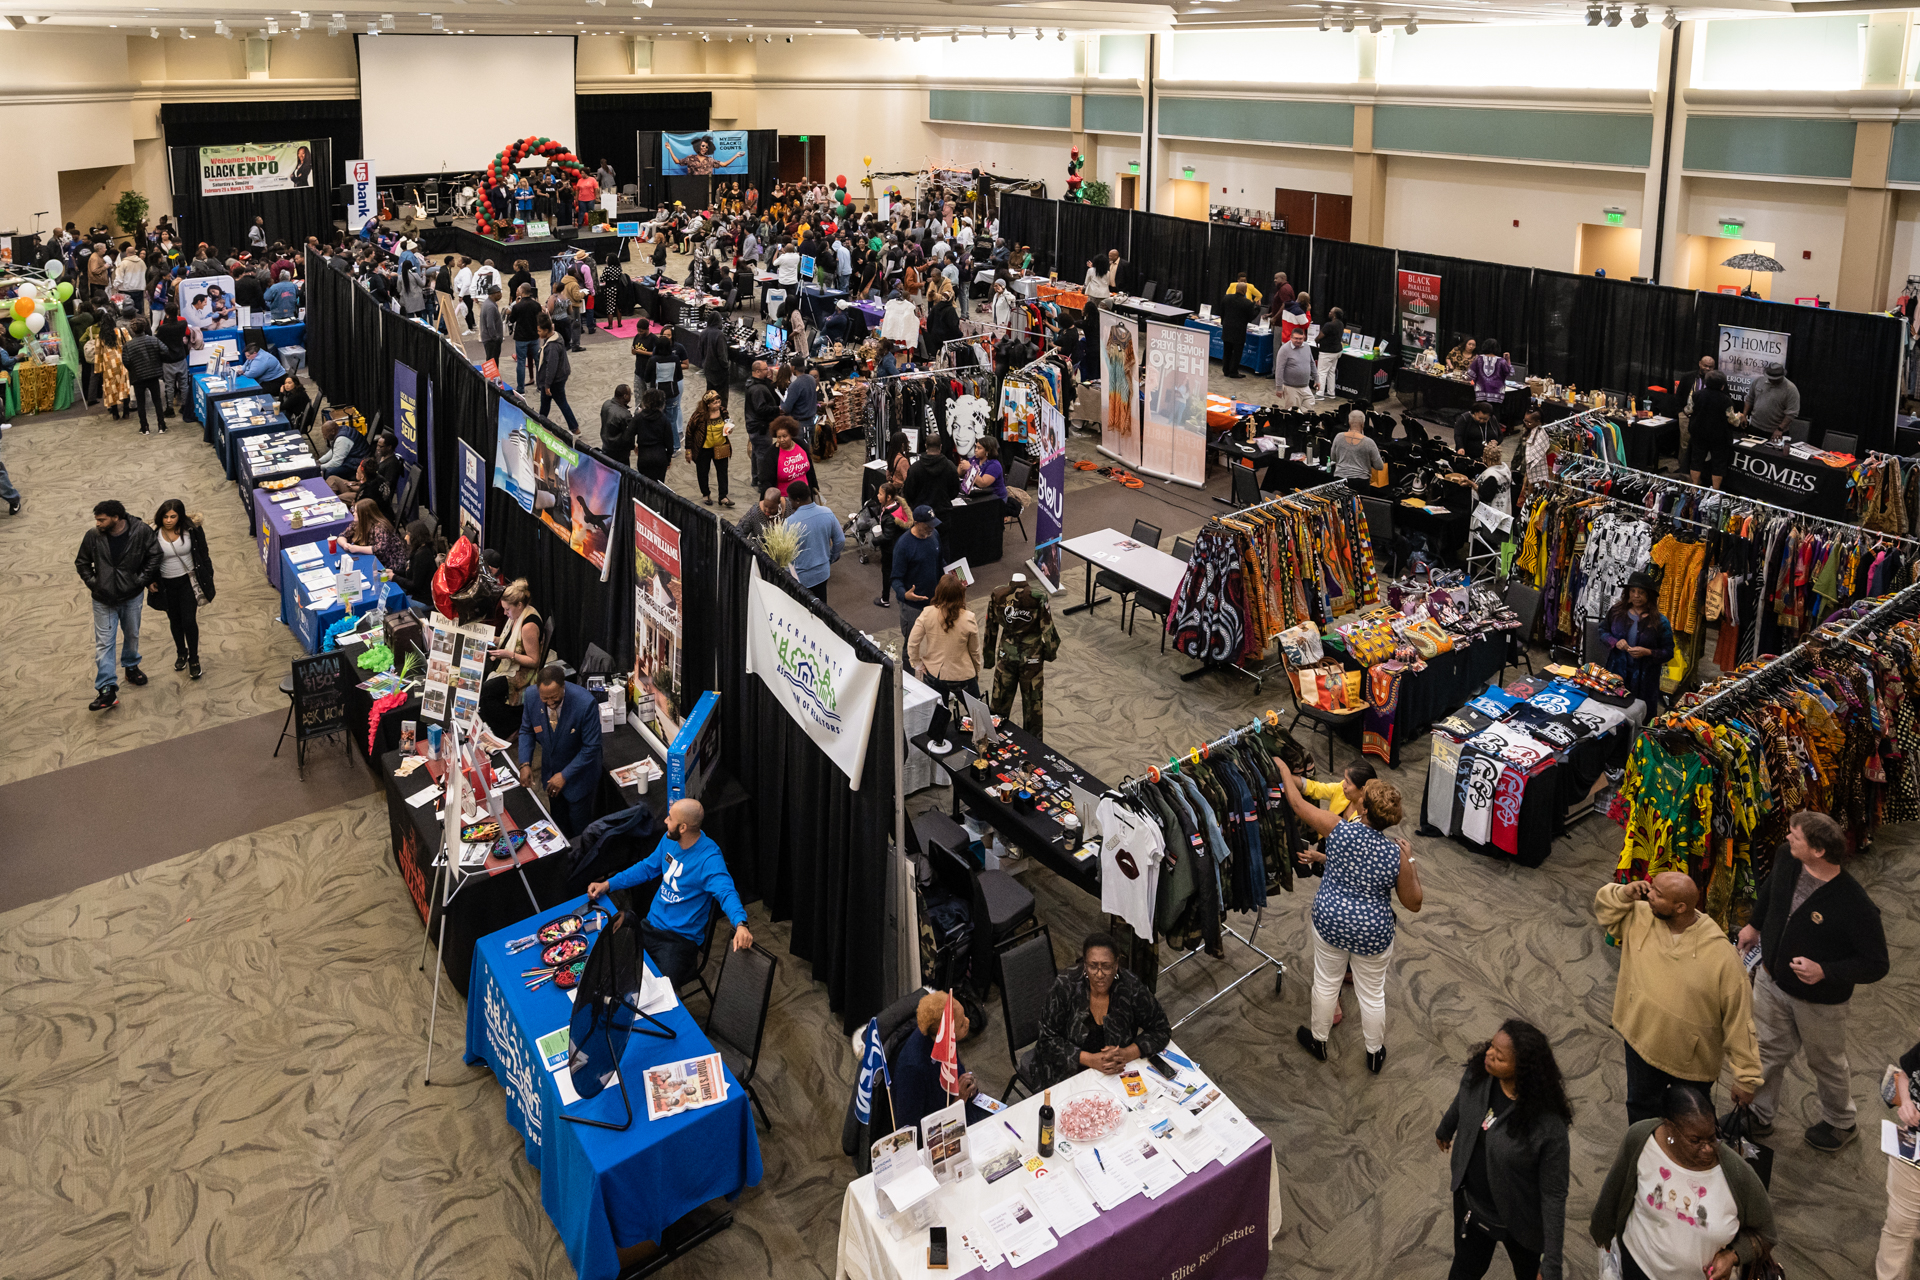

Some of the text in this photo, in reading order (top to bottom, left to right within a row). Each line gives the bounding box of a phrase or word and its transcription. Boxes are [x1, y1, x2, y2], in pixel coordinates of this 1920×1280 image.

[204, 161, 279, 178] BLACK EXPO
[358, 182, 370, 218] bank
[1608, 213, 1621, 222] EXIT
[1724, 224, 1739, 234] EXIT
[1408, 274, 1430, 286] BLACK
[1408, 283, 1431, 293] PARALLEL
[1402, 290, 1420, 299] SCHOOL
[1741, 337, 1782, 354] HOMES
[1726, 375, 1751, 385] ERIOUS
[1342, 386, 1358, 395] BOARD
[402, 422, 416, 442] SEIU
[784, 453, 804, 466] Faith
[790, 462, 808, 474] Hope
[1732, 451, 1817, 492] HOMES
[460, 484, 478, 506] Department
[464, 478, 478, 497] California
[461, 496, 480, 520] Public Health
[636, 520, 679, 562] KELLER WILLIAMS
[642, 536, 670, 562] REALTY
[1004, 606, 1032, 624] Queen
[472, 624, 488, 638] Realty
[769, 612, 842, 677] SACRAMENTO
[302, 704, 345, 726] ASK HOW
[802, 700, 840, 734] OF REALTORS
[696, 1060, 706, 1085] TODAY'S
[702, 1083, 712, 1100] TIMES
[506, 1086, 516, 1099] OF
[1171, 1224, 1256, 1280] Elite Real Estate
